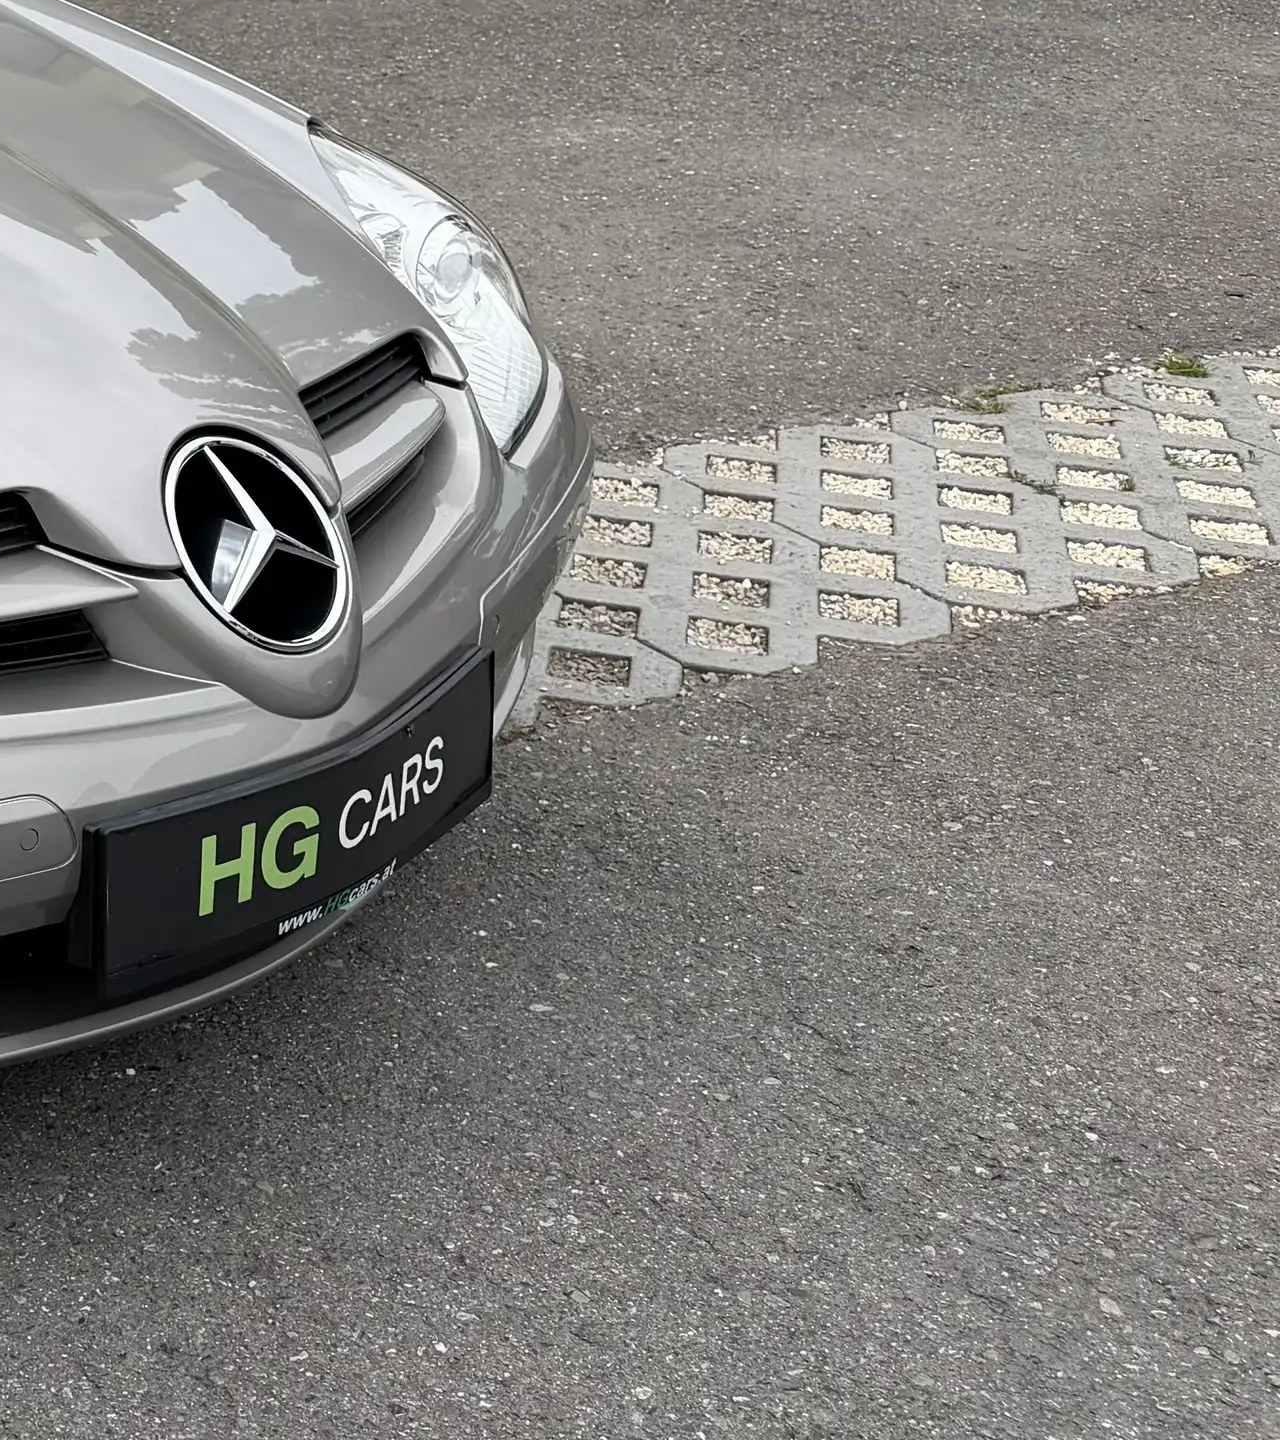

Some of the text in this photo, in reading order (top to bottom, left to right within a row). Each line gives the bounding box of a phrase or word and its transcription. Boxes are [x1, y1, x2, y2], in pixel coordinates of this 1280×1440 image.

[199, 736, 444, 917] HG CARS
[278, 857, 397, 936] www.HGcars.at
